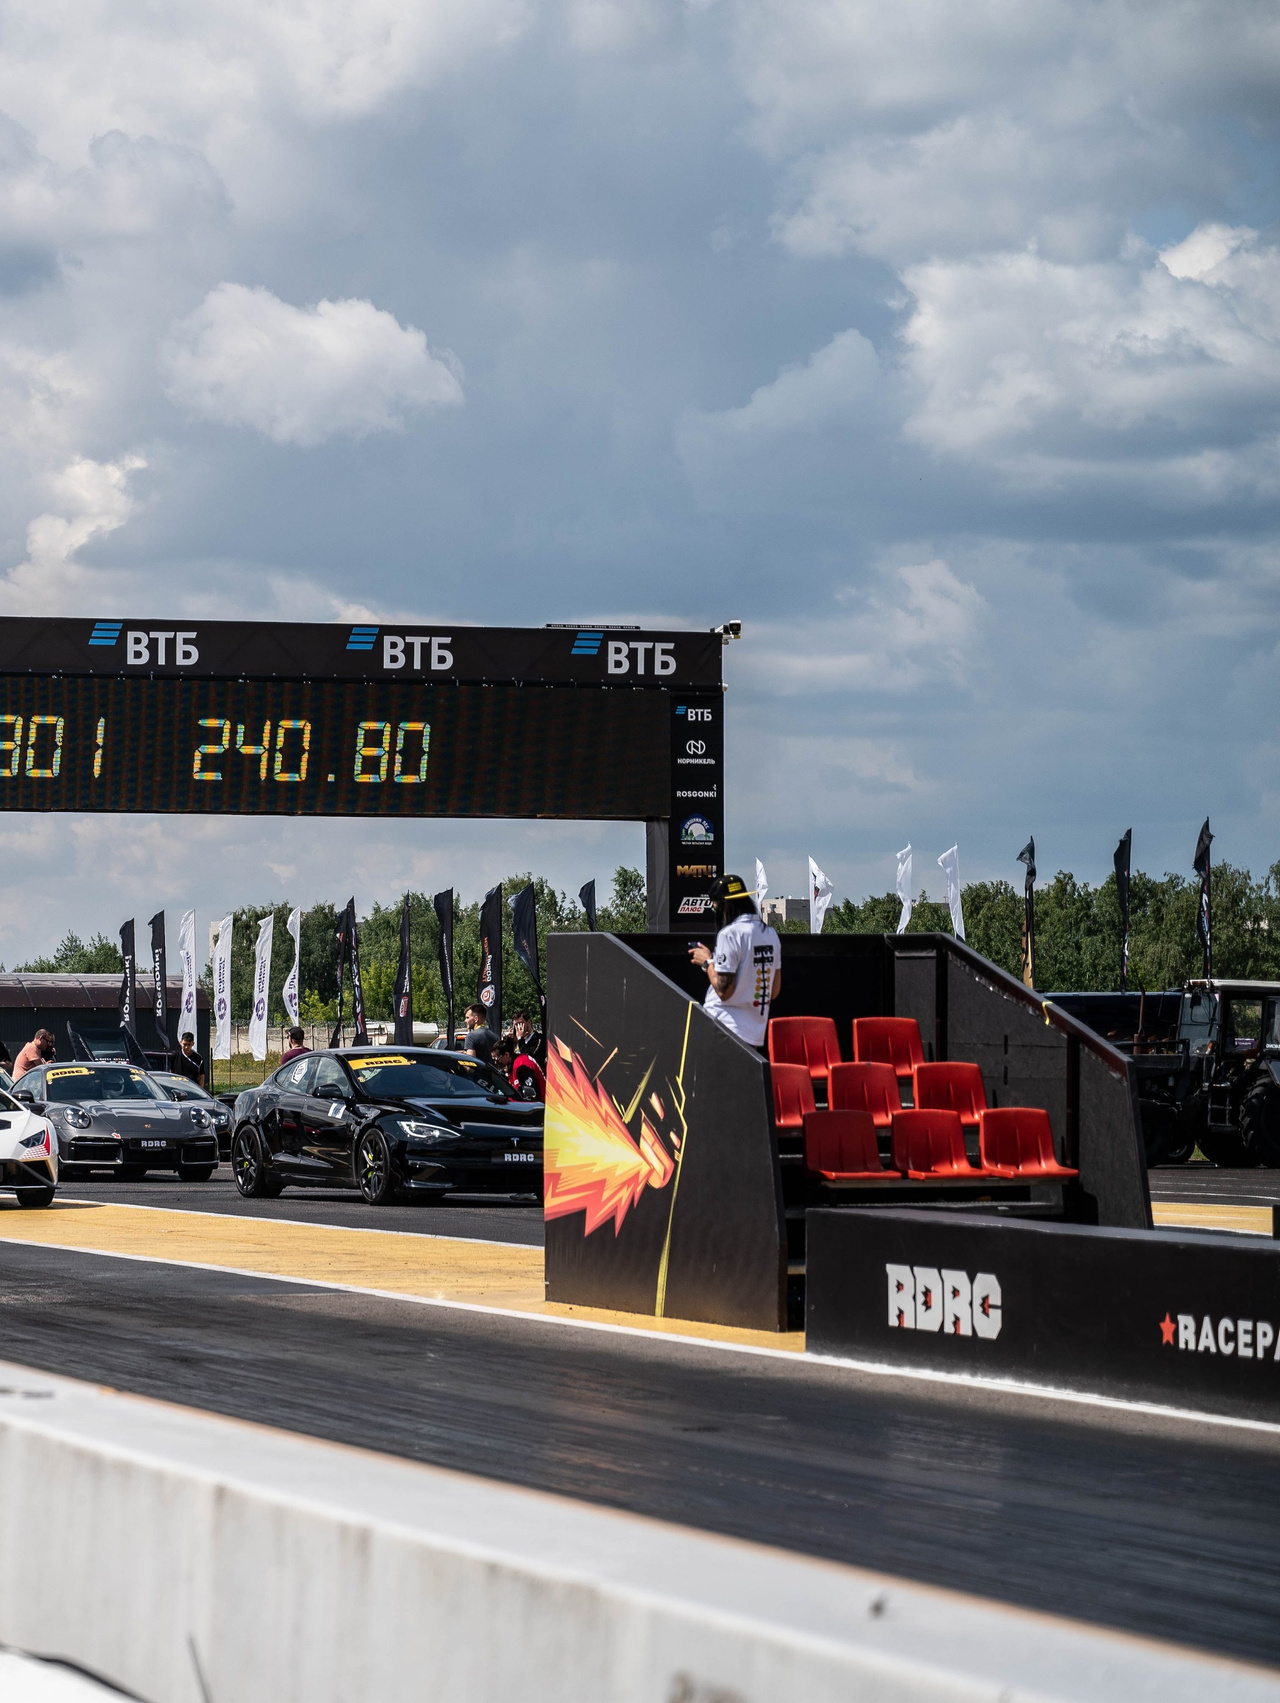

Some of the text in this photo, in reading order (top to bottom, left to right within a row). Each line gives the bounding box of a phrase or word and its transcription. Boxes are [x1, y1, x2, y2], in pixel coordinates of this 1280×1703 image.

[126, 630, 199, 666] ВТБ
[383, 635, 454, 670] ВТБ
[607, 641, 677, 676] ВТБ
[687, 708, 713, 721] ВТБ
[193, 719, 431, 783] 240.80
[676, 865, 717, 878] МАТЧ!
[51, 1069, 84, 1077] RDRC
[504, 1153, 535, 1162] RDRC
[885, 1263, 1002, 1340] RDRC
